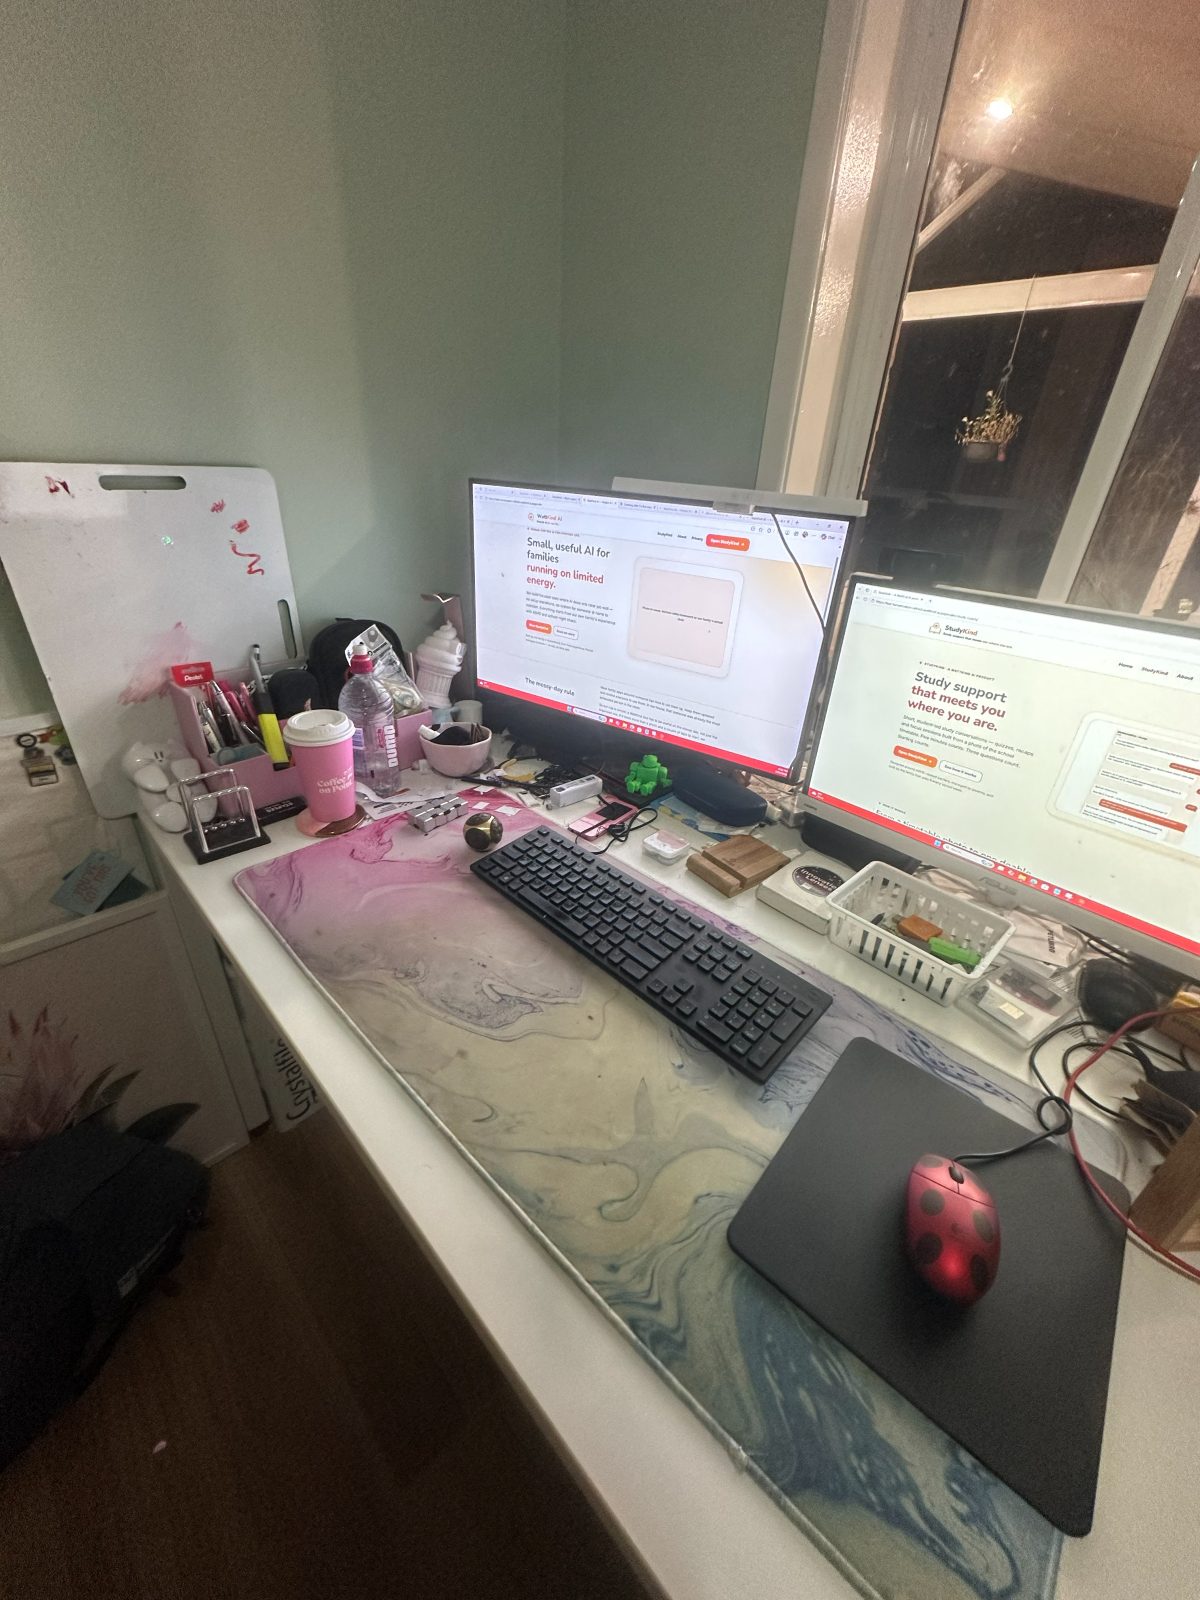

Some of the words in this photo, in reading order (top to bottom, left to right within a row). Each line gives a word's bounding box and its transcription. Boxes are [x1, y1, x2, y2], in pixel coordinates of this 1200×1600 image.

[527, 537, 553, 550] Small,
[556, 544, 582, 554] useful
[584, 546, 594, 556] AI
[597, 547, 610, 558] for
[527, 550, 559, 563] families
[527, 564, 558, 578] running
[560, 570, 571, 578] on
[573, 570, 604, 584] limited
[527, 577, 556, 589] energy.
[945, 625, 978, 636] StudyKind
[525, 677, 535, 686] The
[915, 672, 951, 690] Study
[953, 683, 1007, 703] support
[911, 685, 937, 700] that
[939, 694, 978, 710] meets
[981, 705, 1006, 718] you
[908, 700, 944, 716] where
[947, 710, 970, 724] you
[973, 718, 997, 731] are.
[317, 777, 346, 787] Coffee
[805, 875, 833, 891] Lenses
